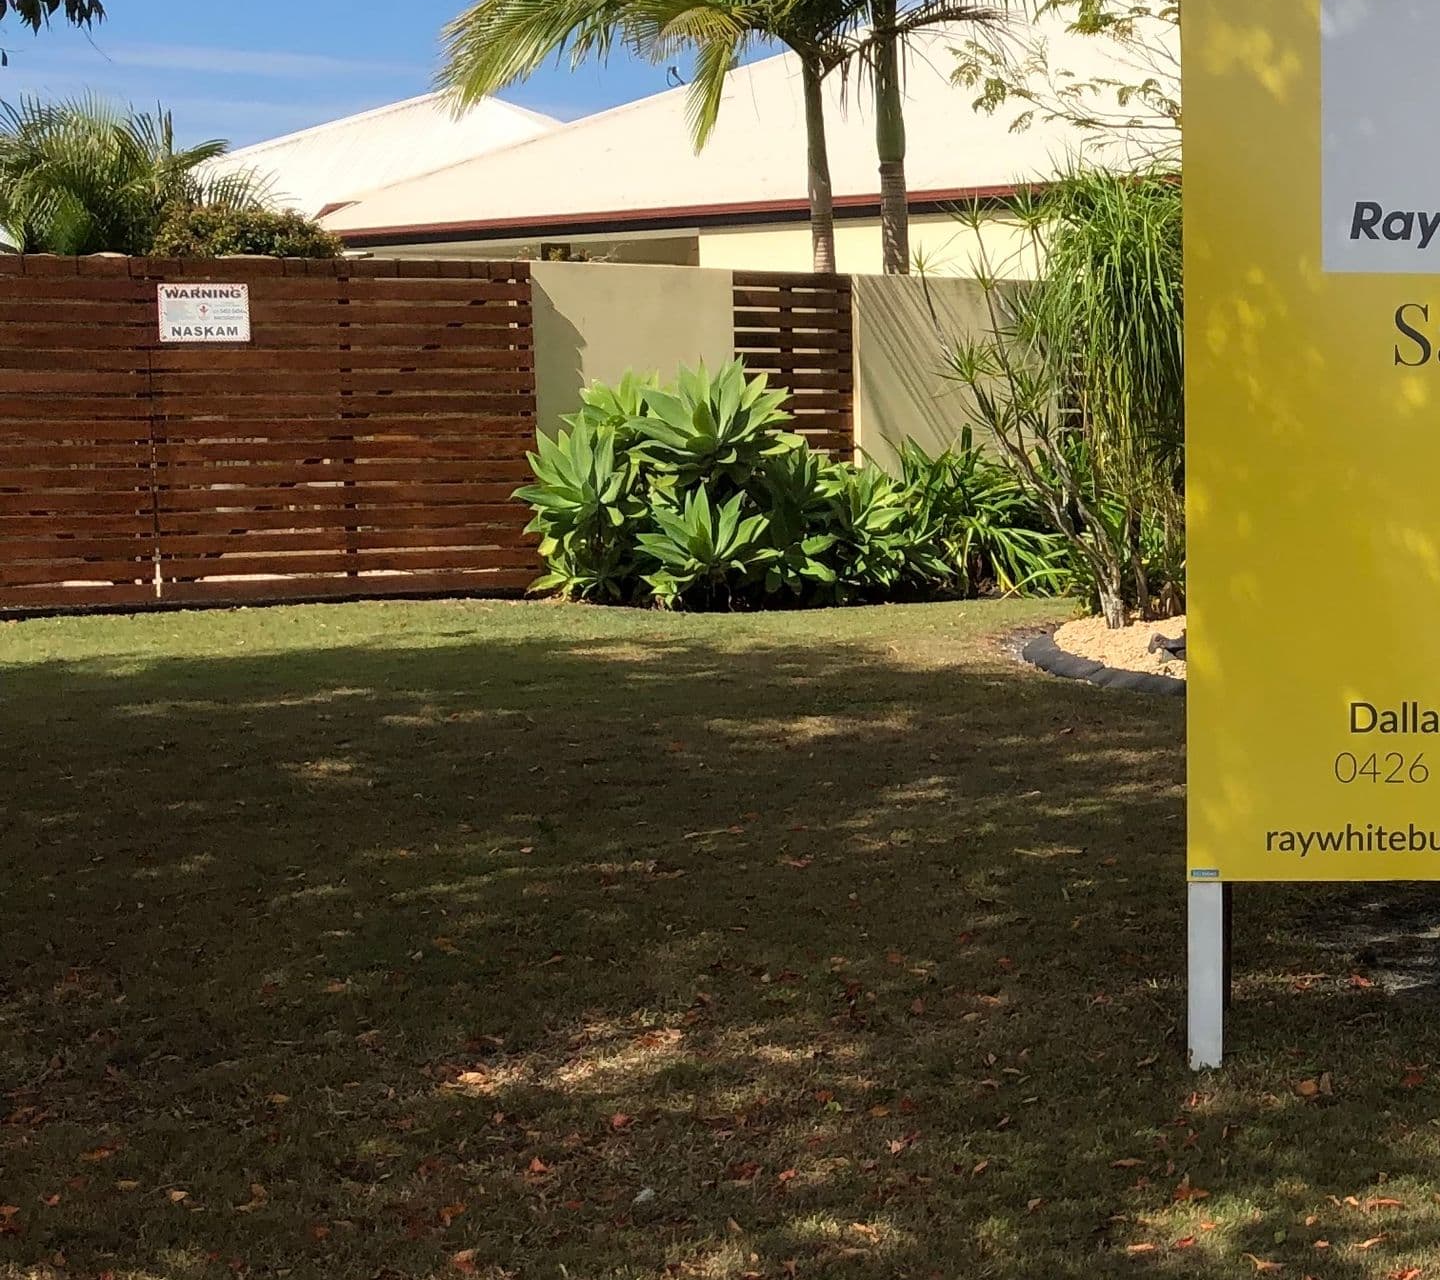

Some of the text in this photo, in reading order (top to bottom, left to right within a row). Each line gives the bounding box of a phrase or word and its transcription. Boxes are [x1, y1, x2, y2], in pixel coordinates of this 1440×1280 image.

[164, 288, 241, 299] WARNING
[171, 326, 239, 337] NASKAM
[1334, 751, 1430, 784] 0426
